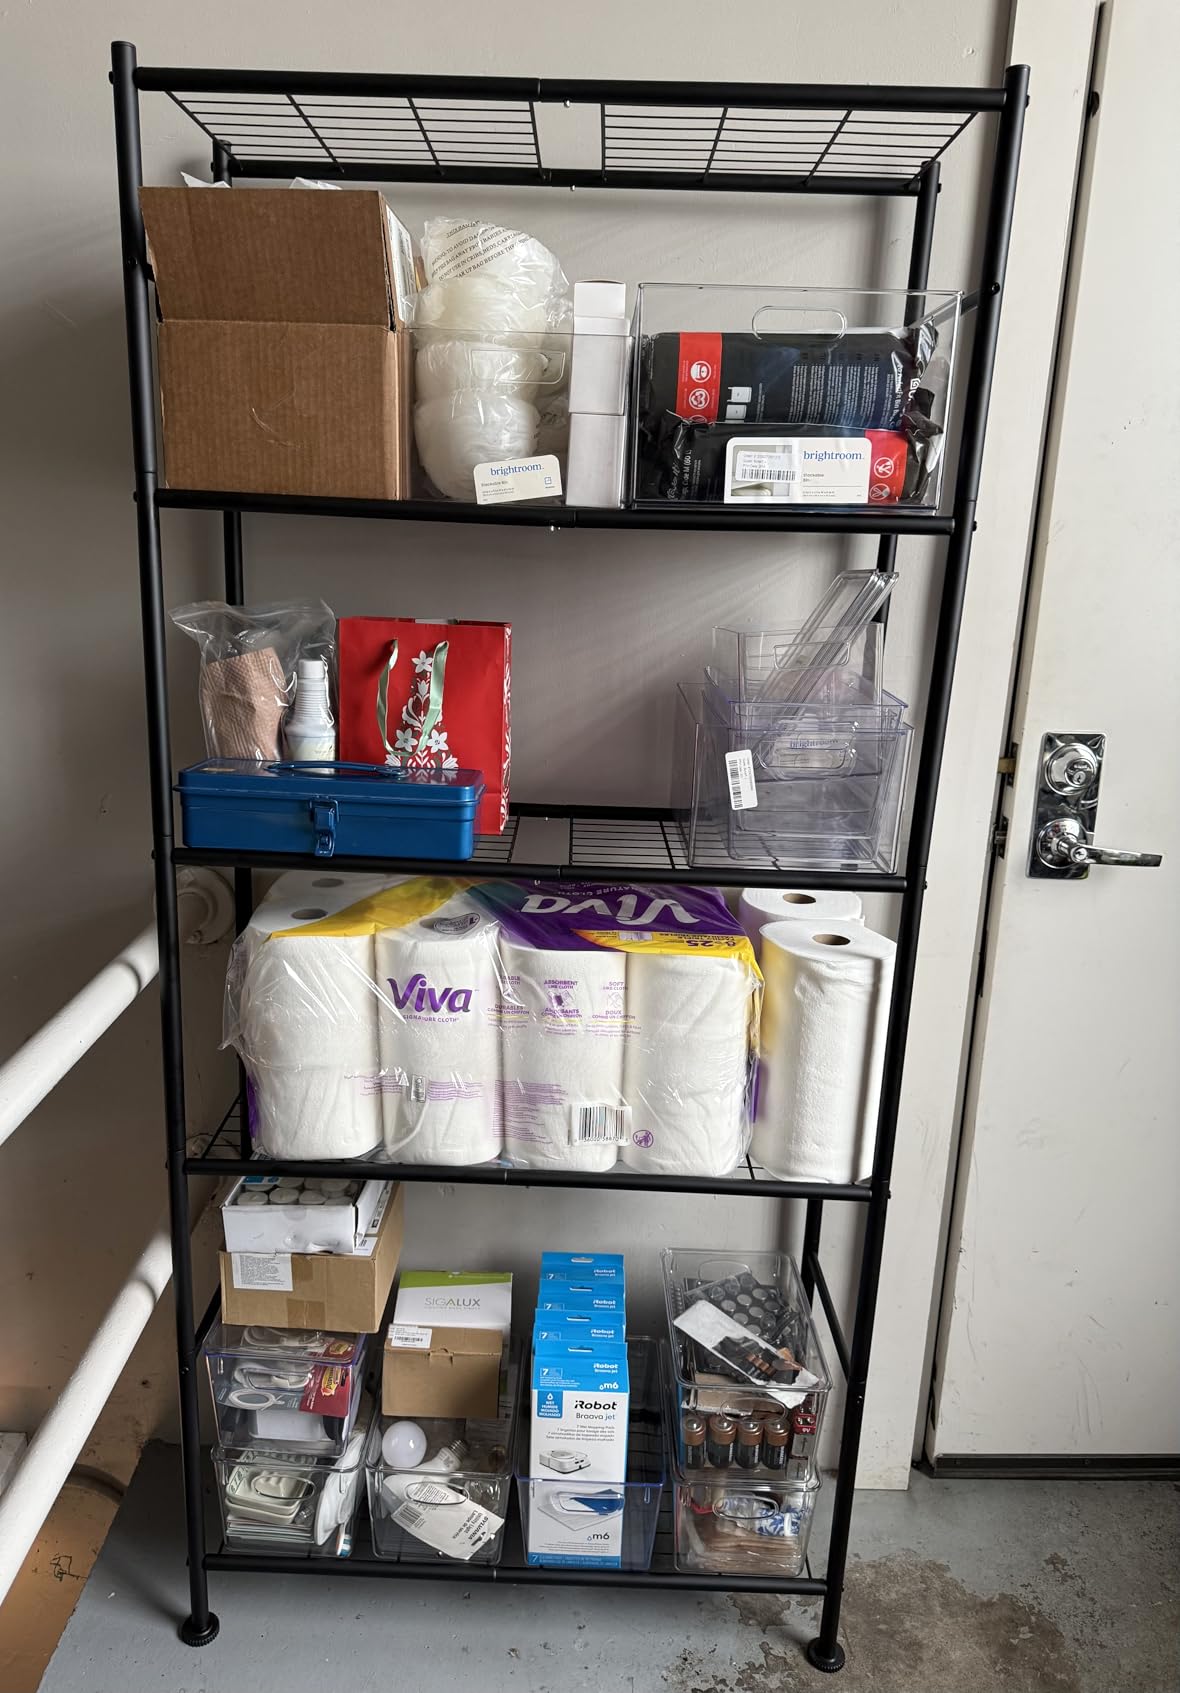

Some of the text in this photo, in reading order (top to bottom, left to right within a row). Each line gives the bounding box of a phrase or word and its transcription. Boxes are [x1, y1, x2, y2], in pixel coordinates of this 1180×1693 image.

[519, 894, 701, 926] Viva
[686, 940, 714, 948] 25
[386, 973, 473, 1013] Viva
[424, 1298, 481, 1307] SIGALUX
[541, 1332, 548, 1340] 7
[574, 1400, 618, 1410] iRobot
[605, 1413, 616, 1421] jet
[468, 1516, 489, 1540] SYLVANIA
[592, 1532, 610, 1540] m6
